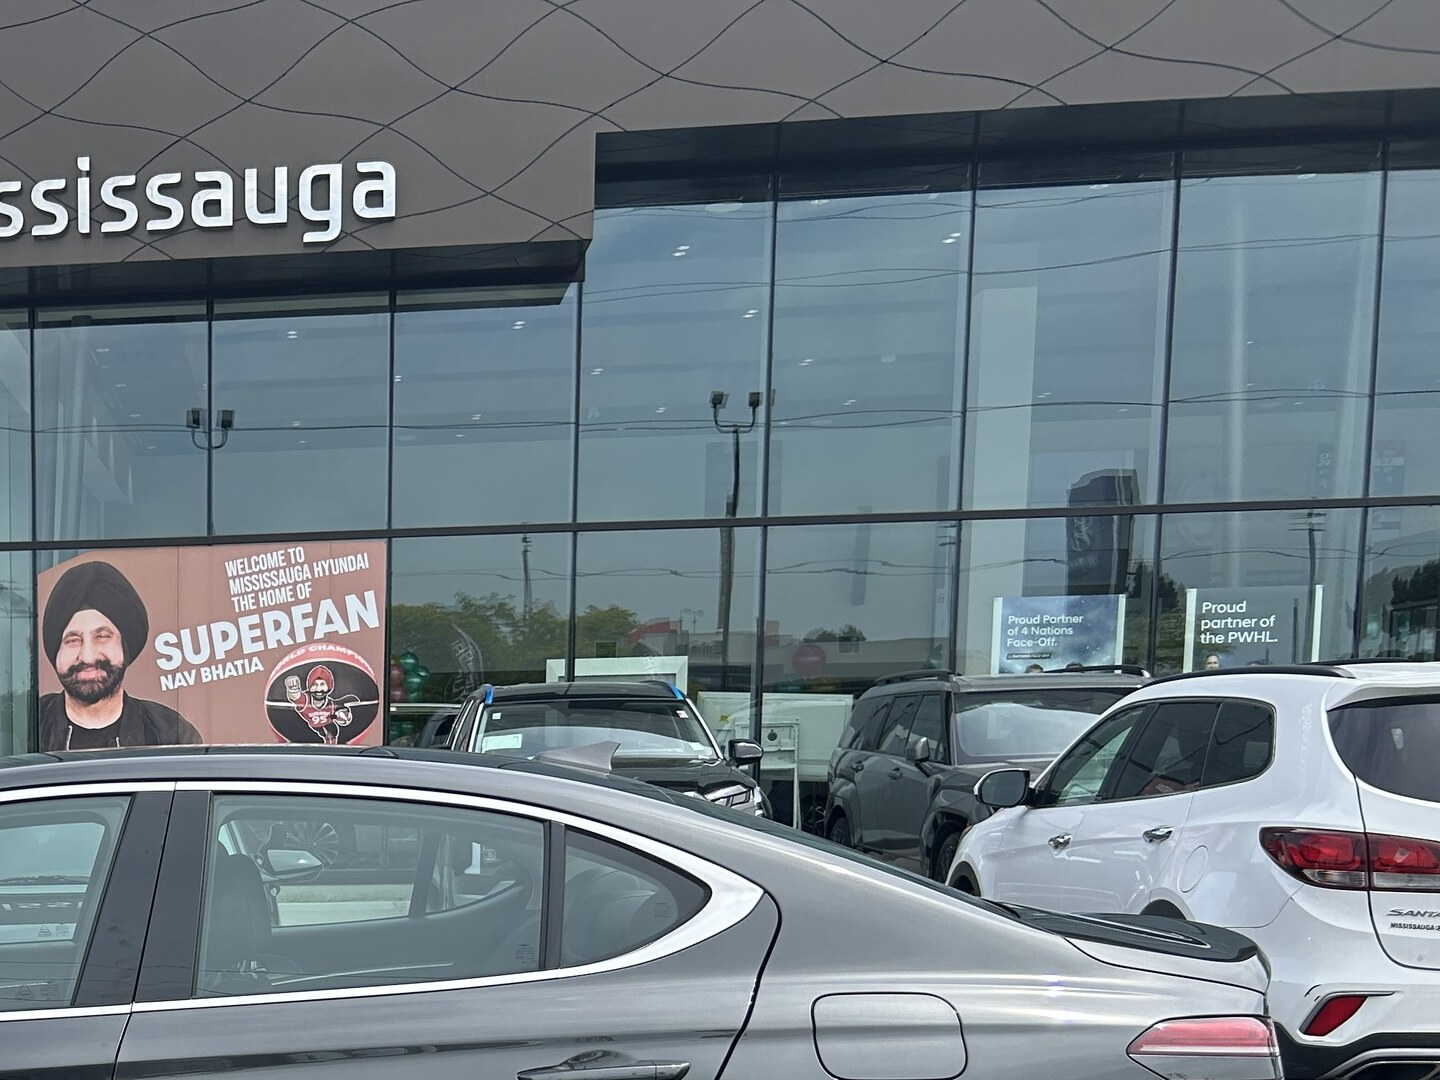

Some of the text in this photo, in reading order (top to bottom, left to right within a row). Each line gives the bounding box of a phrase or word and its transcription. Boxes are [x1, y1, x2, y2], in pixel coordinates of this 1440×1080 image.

[225, 546, 305, 577] WELCOME TO
[229, 552, 369, 596] MISSISSAUGA HYUNDAI
[231, 582, 312, 613] THE HOME OF
[1201, 601, 1247, 614] Proud
[1008, 614, 1084, 625] Proud Partner
[1200, 615, 1276, 631] partner of
[154, 590, 380, 671] SUPERFAN
[1007, 626, 1019, 636] of
[1031, 626, 1074, 635] Nations
[1200, 631, 1278, 644] the PWHL.
[1006, 637, 1058, 647] Face-Off.
[160, 656, 265, 691] NAV BHATIA
[312, 716, 328, 724] 95
